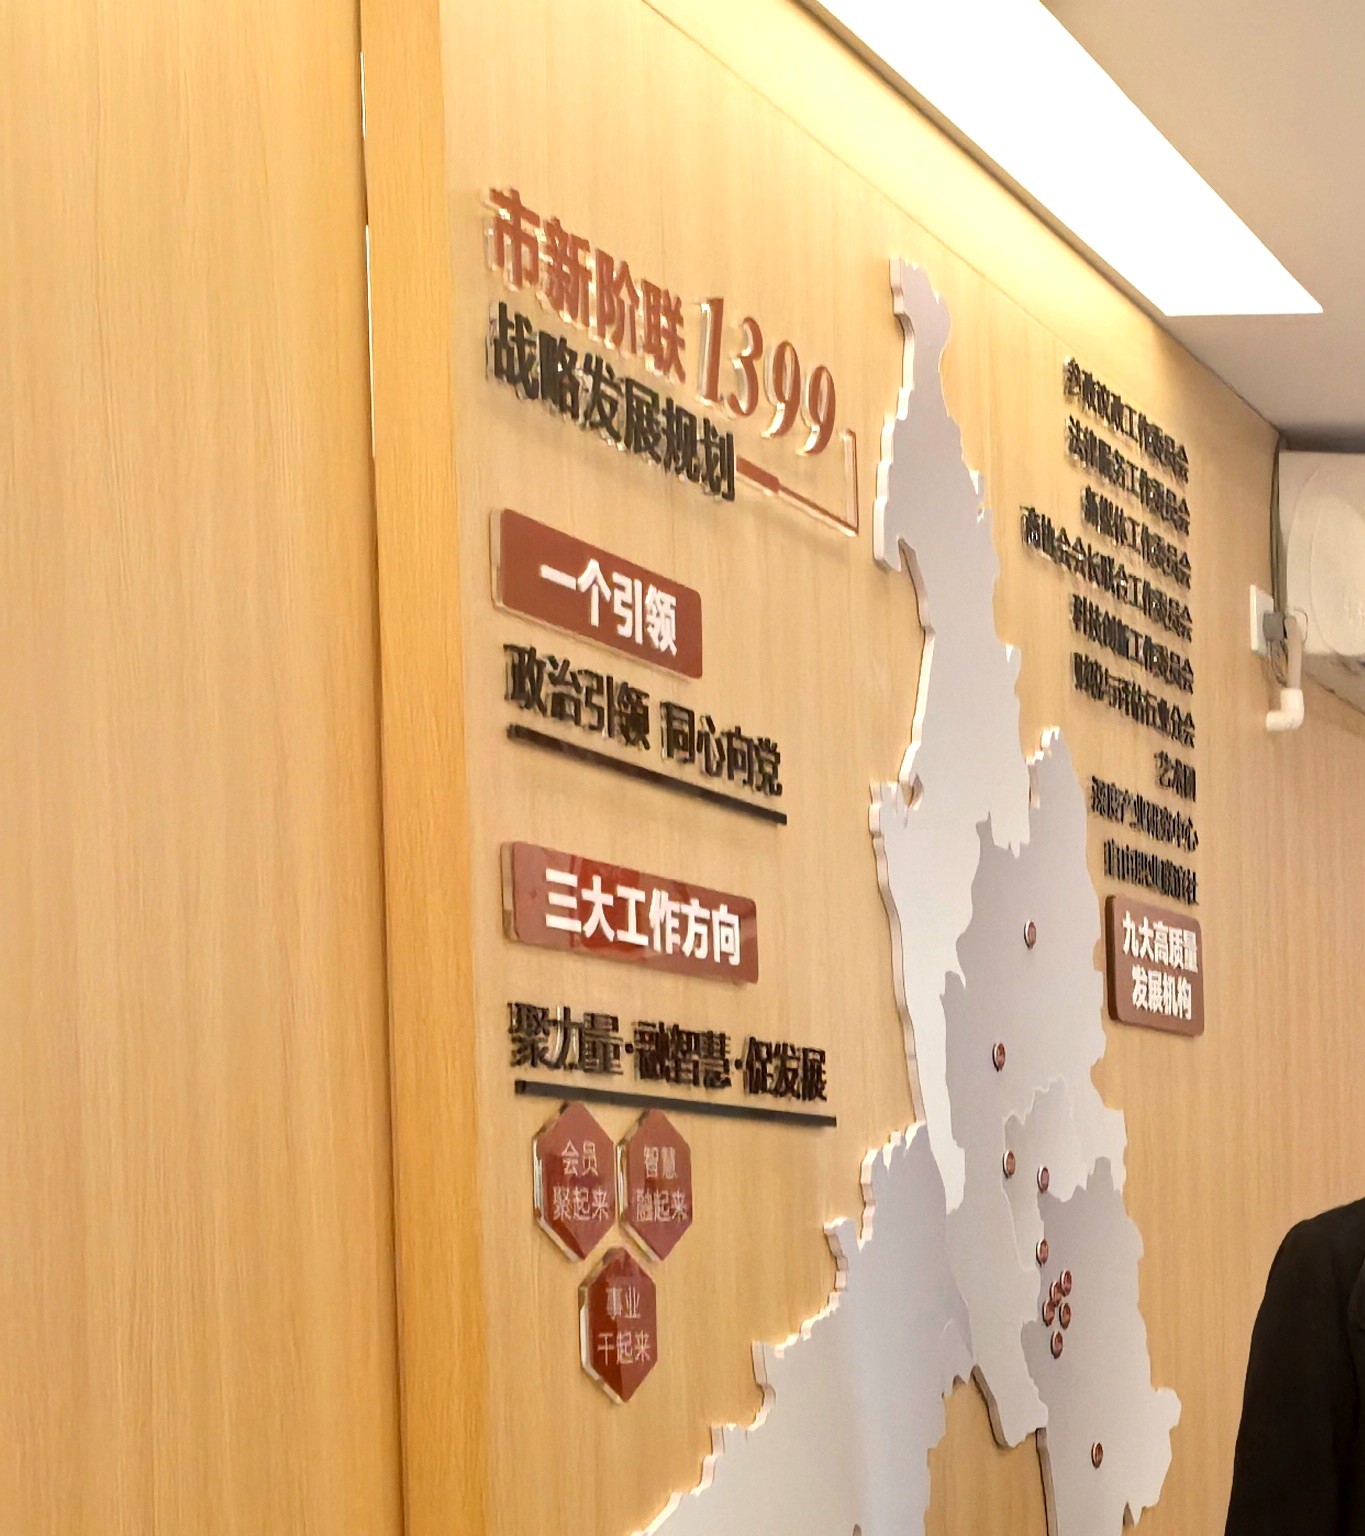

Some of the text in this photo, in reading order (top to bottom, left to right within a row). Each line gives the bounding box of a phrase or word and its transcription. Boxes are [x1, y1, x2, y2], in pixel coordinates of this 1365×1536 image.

[493, 301, 736, 502] 战略发展规划
[540, 559, 678, 656] 一个引领
[503, 643, 783, 797] 政治引领 同心向党
[545, 867, 741, 966] 三大工作方向
[1122, 911, 1199, 973] 九大高质量
[1131, 963, 1193, 1021] 发展机构
[561, 1139, 598, 1177] 会员
[643, 1145, 677, 1179] 智慧
[553, 1186, 610, 1222] 聚起来
[636, 1188, 689, 1223] 融起来
[606, 1286, 641, 1320] 事业
[597, 1330, 651, 1367] 干起来
